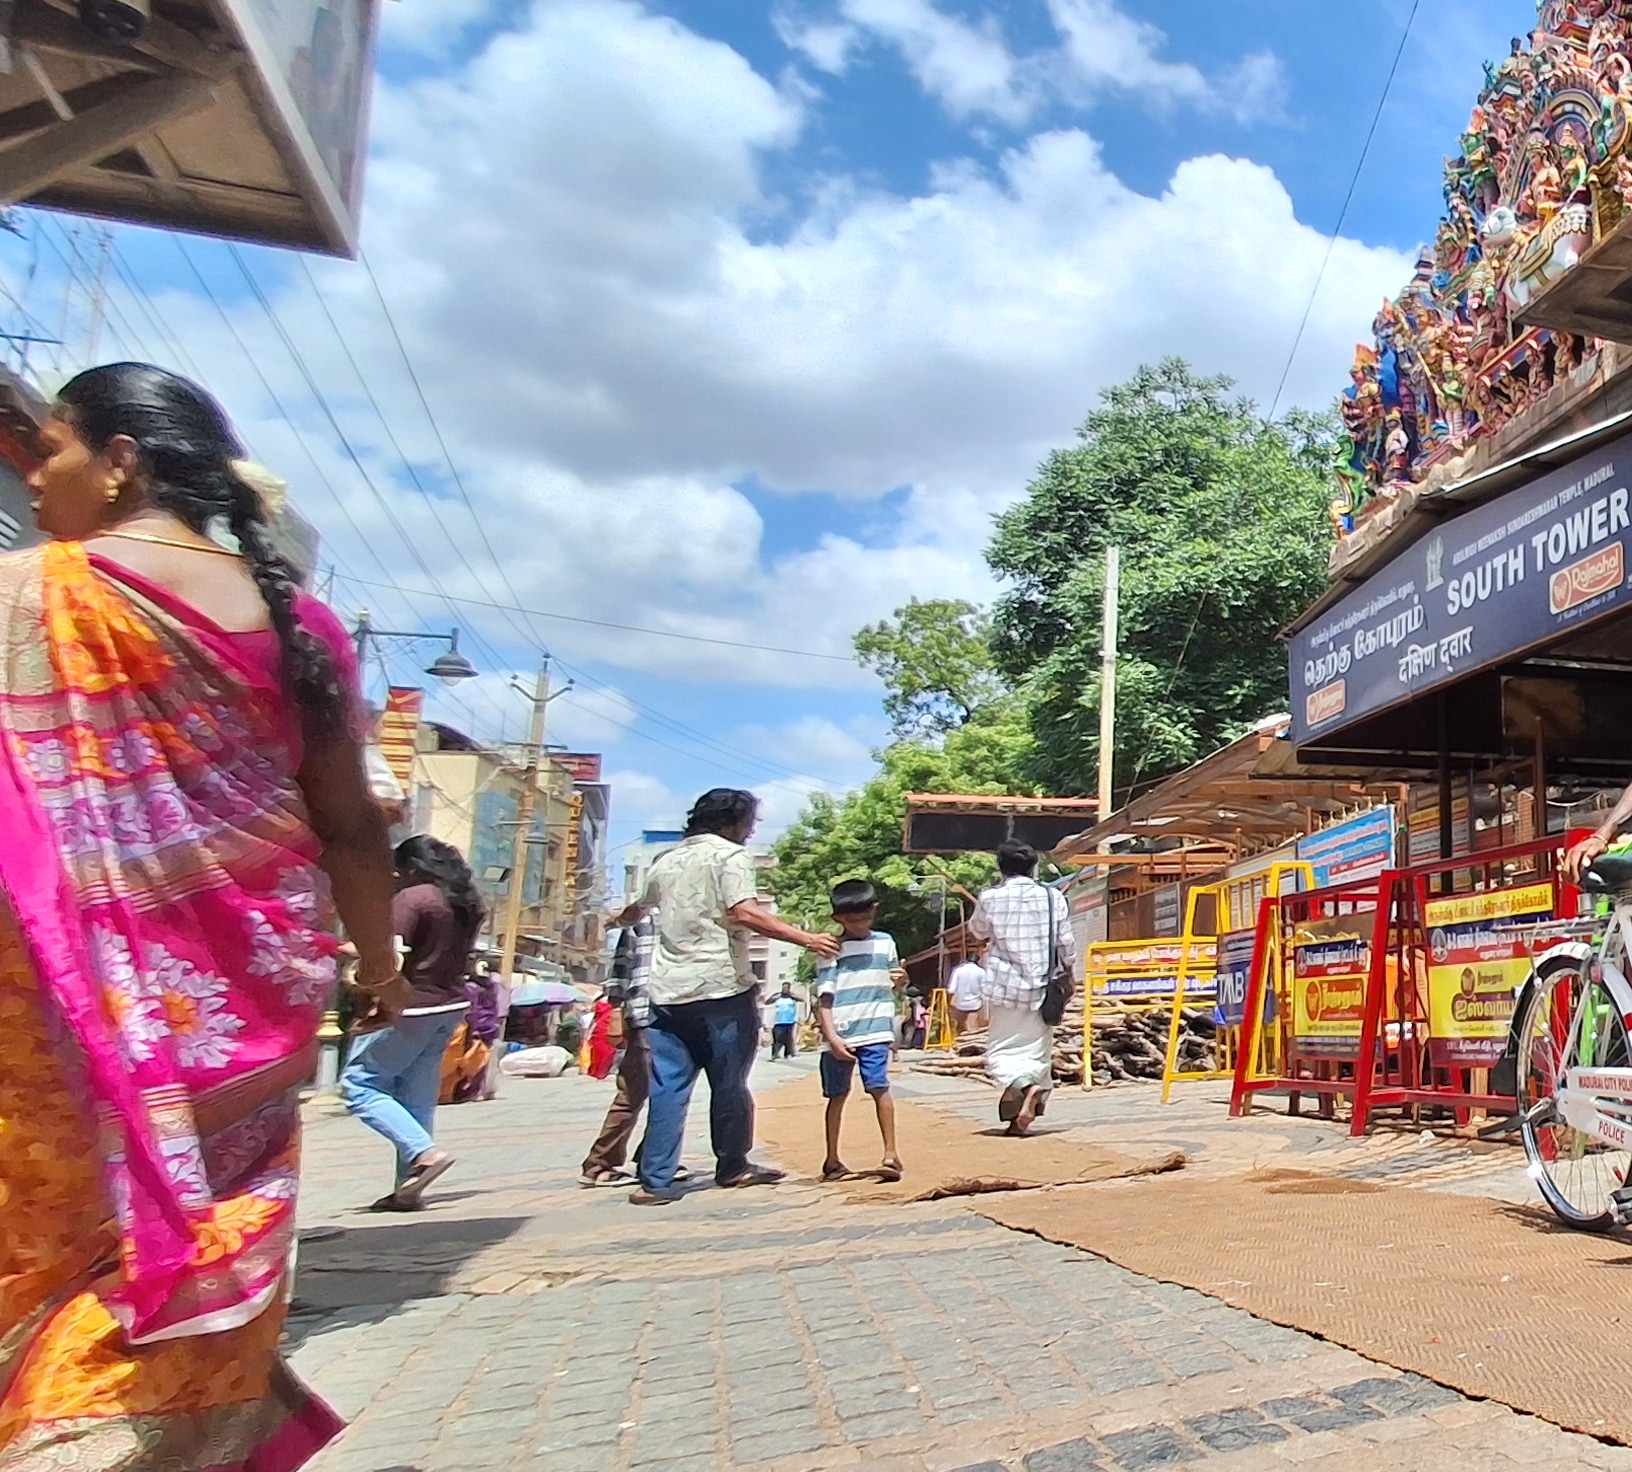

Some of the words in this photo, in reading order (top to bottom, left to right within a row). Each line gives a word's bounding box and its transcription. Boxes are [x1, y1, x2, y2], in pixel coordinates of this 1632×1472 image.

[1447, 544, 1525, 616] SOUTH
[1532, 488, 1631, 572] TOWER
[1572, 548, 1619, 592] Rajmahal
[1304, 641, 1352, 688] தெற்கு
[1354, 594, 1424, 661] கோபுரம்
[1398, 644, 1438, 684] दक्षिण
[1578, 1075, 1603, 1090] MADURAI
[1603, 1076, 1618, 1091] CITY
[1599, 1121, 1626, 1144] POLICE
